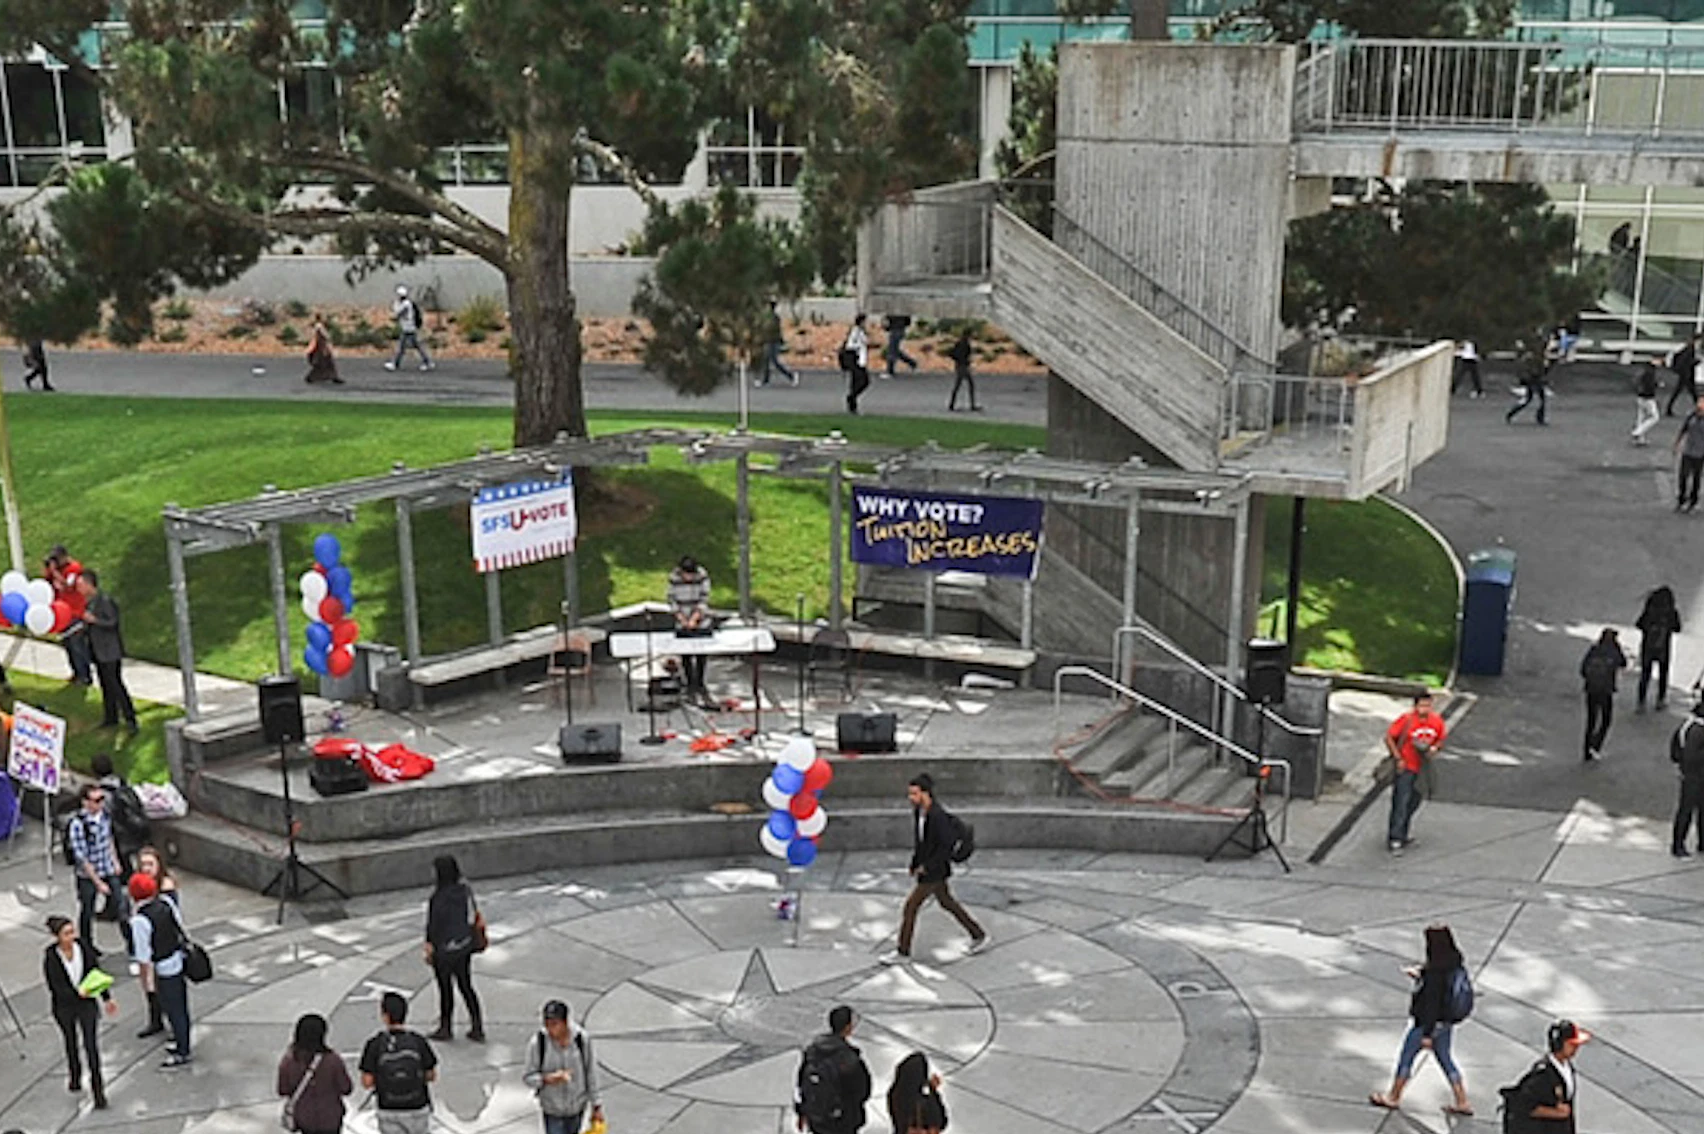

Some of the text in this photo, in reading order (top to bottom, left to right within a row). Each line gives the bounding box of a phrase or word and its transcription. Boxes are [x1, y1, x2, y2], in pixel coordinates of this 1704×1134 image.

[856, 495, 984, 525] WHY VOTE?
[905, 531, 1036, 565] INCREASES
